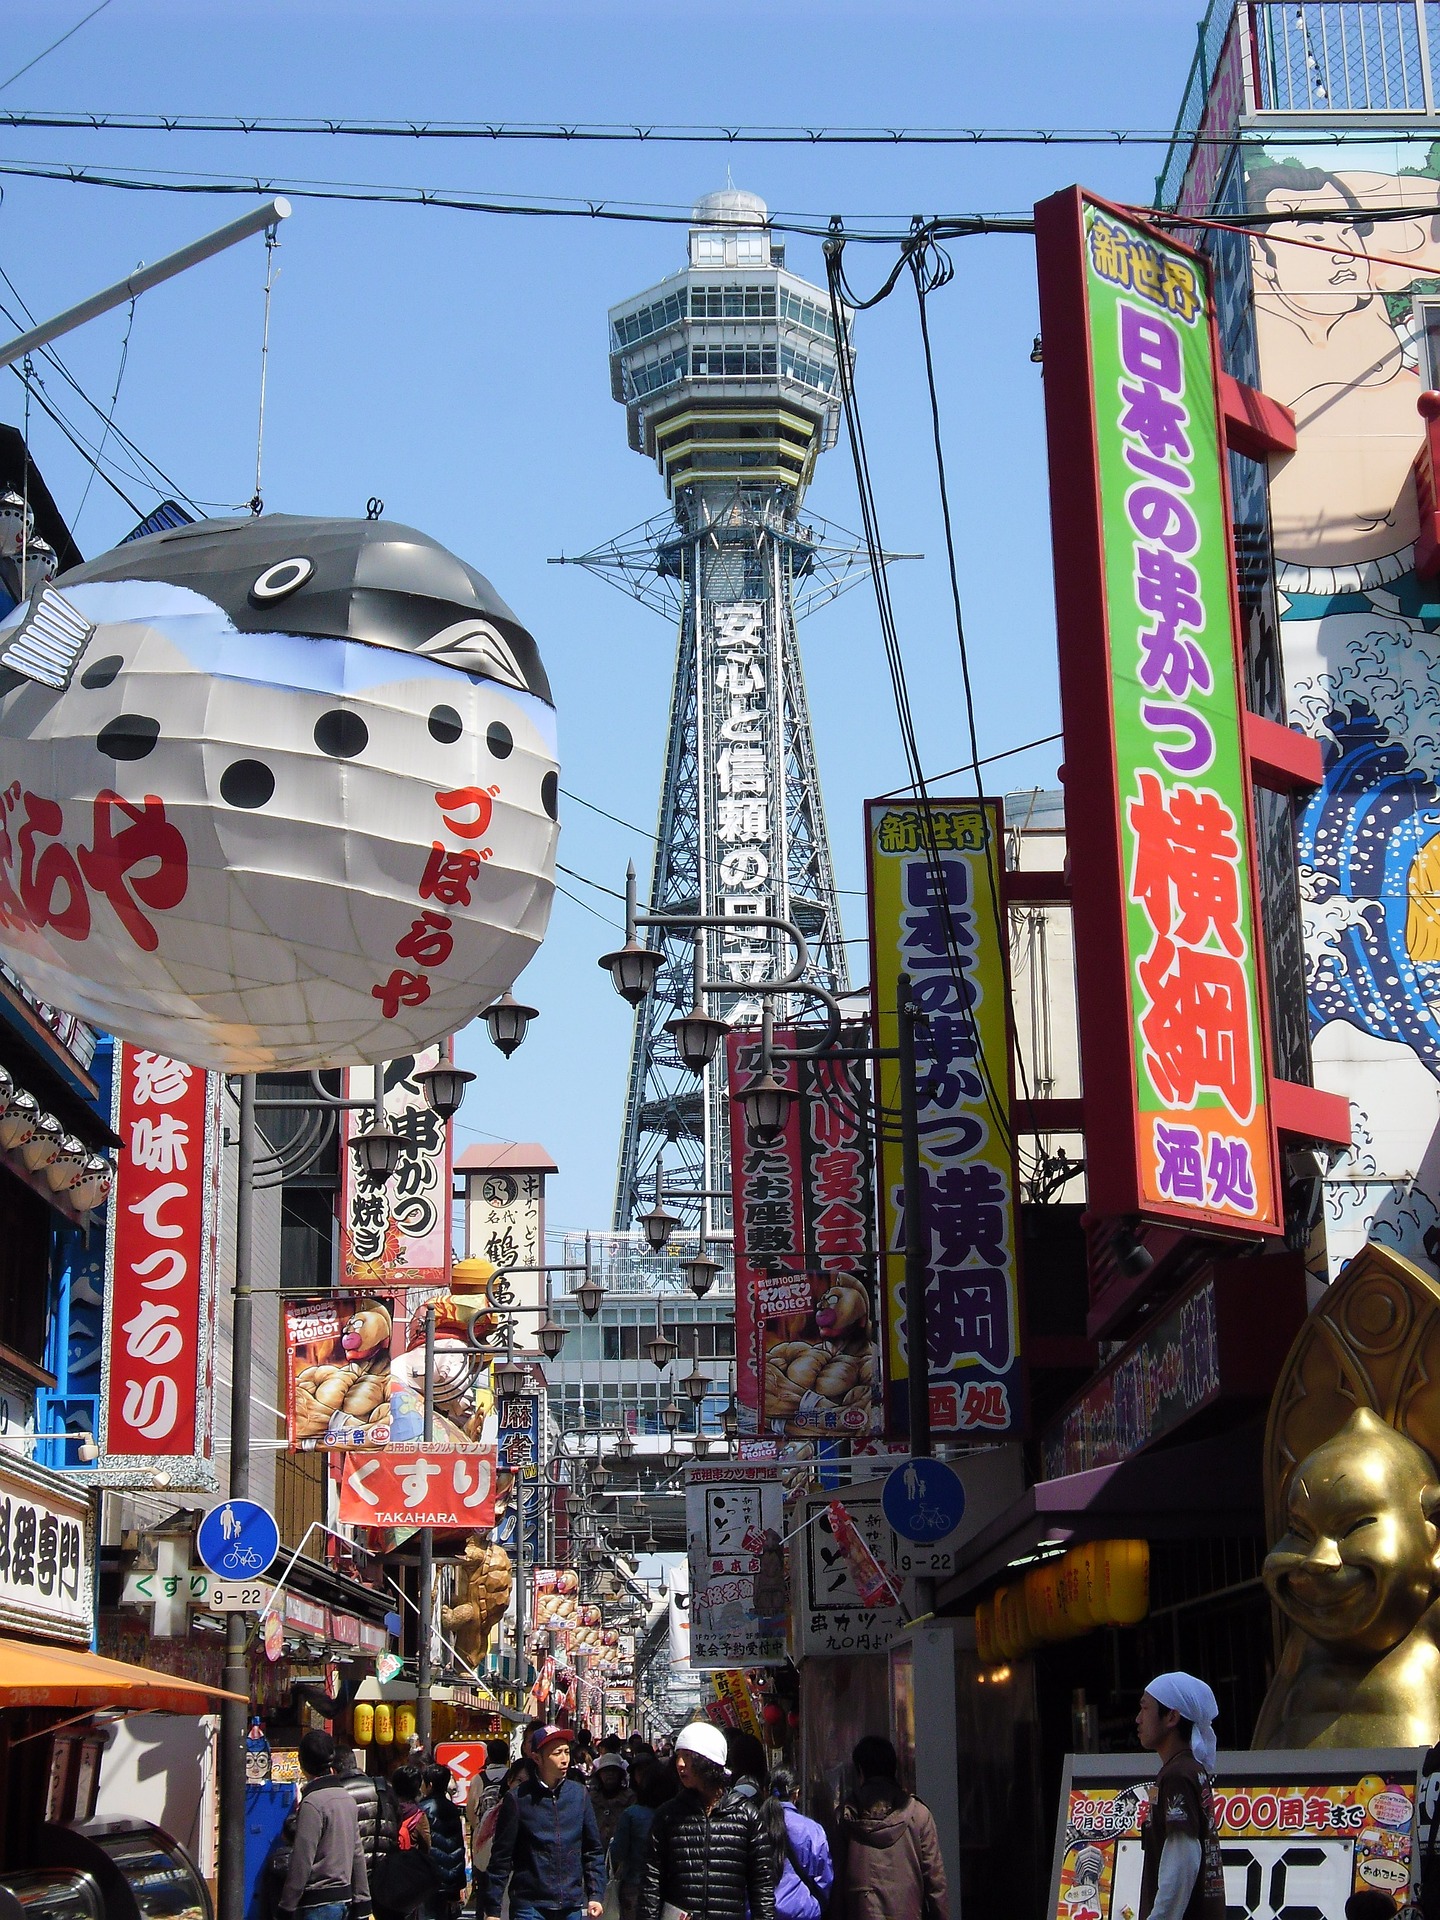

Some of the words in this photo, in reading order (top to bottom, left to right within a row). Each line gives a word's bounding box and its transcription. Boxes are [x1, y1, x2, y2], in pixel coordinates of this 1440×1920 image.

[1091, 219, 1200, 326] 新世界
[715, 603, 772, 1024] 安心と信頼の日立
[881, 811, 986, 852] 新世界
[371, 784, 501, 1018] づぼらや
[1157, 1124, 1256, 1211] 酒処
[484, 1209, 518, 1225] 名代
[758, 1282, 811, 1303] キン肉マン
[760, 1296, 812, 1314] PROJECT
[289, 1322, 339, 1342] PROJECT
[501, 1398, 536, 1464] 麻雀
[741, 1448, 777, 1460] PROJECT
[348, 1457, 491, 1508] くすり
[690, 1467, 778, 1481] 元祖串カツ専門店
[374, 1512, 458, 1524] TAKAHARA
[902, 1554, 951, 1571] 9-22
[136, 1574, 208, 1598] くすり
[213, 1589, 261, 1605] 9-22
[694, 1642, 784, 1658] 宴会予約受付中
[1073, 1800, 1124, 1816] 2012年
[1072, 1815, 1135, 1831] 7月3日(火)
[1363, 1864, 1406, 1884] おめでとう
